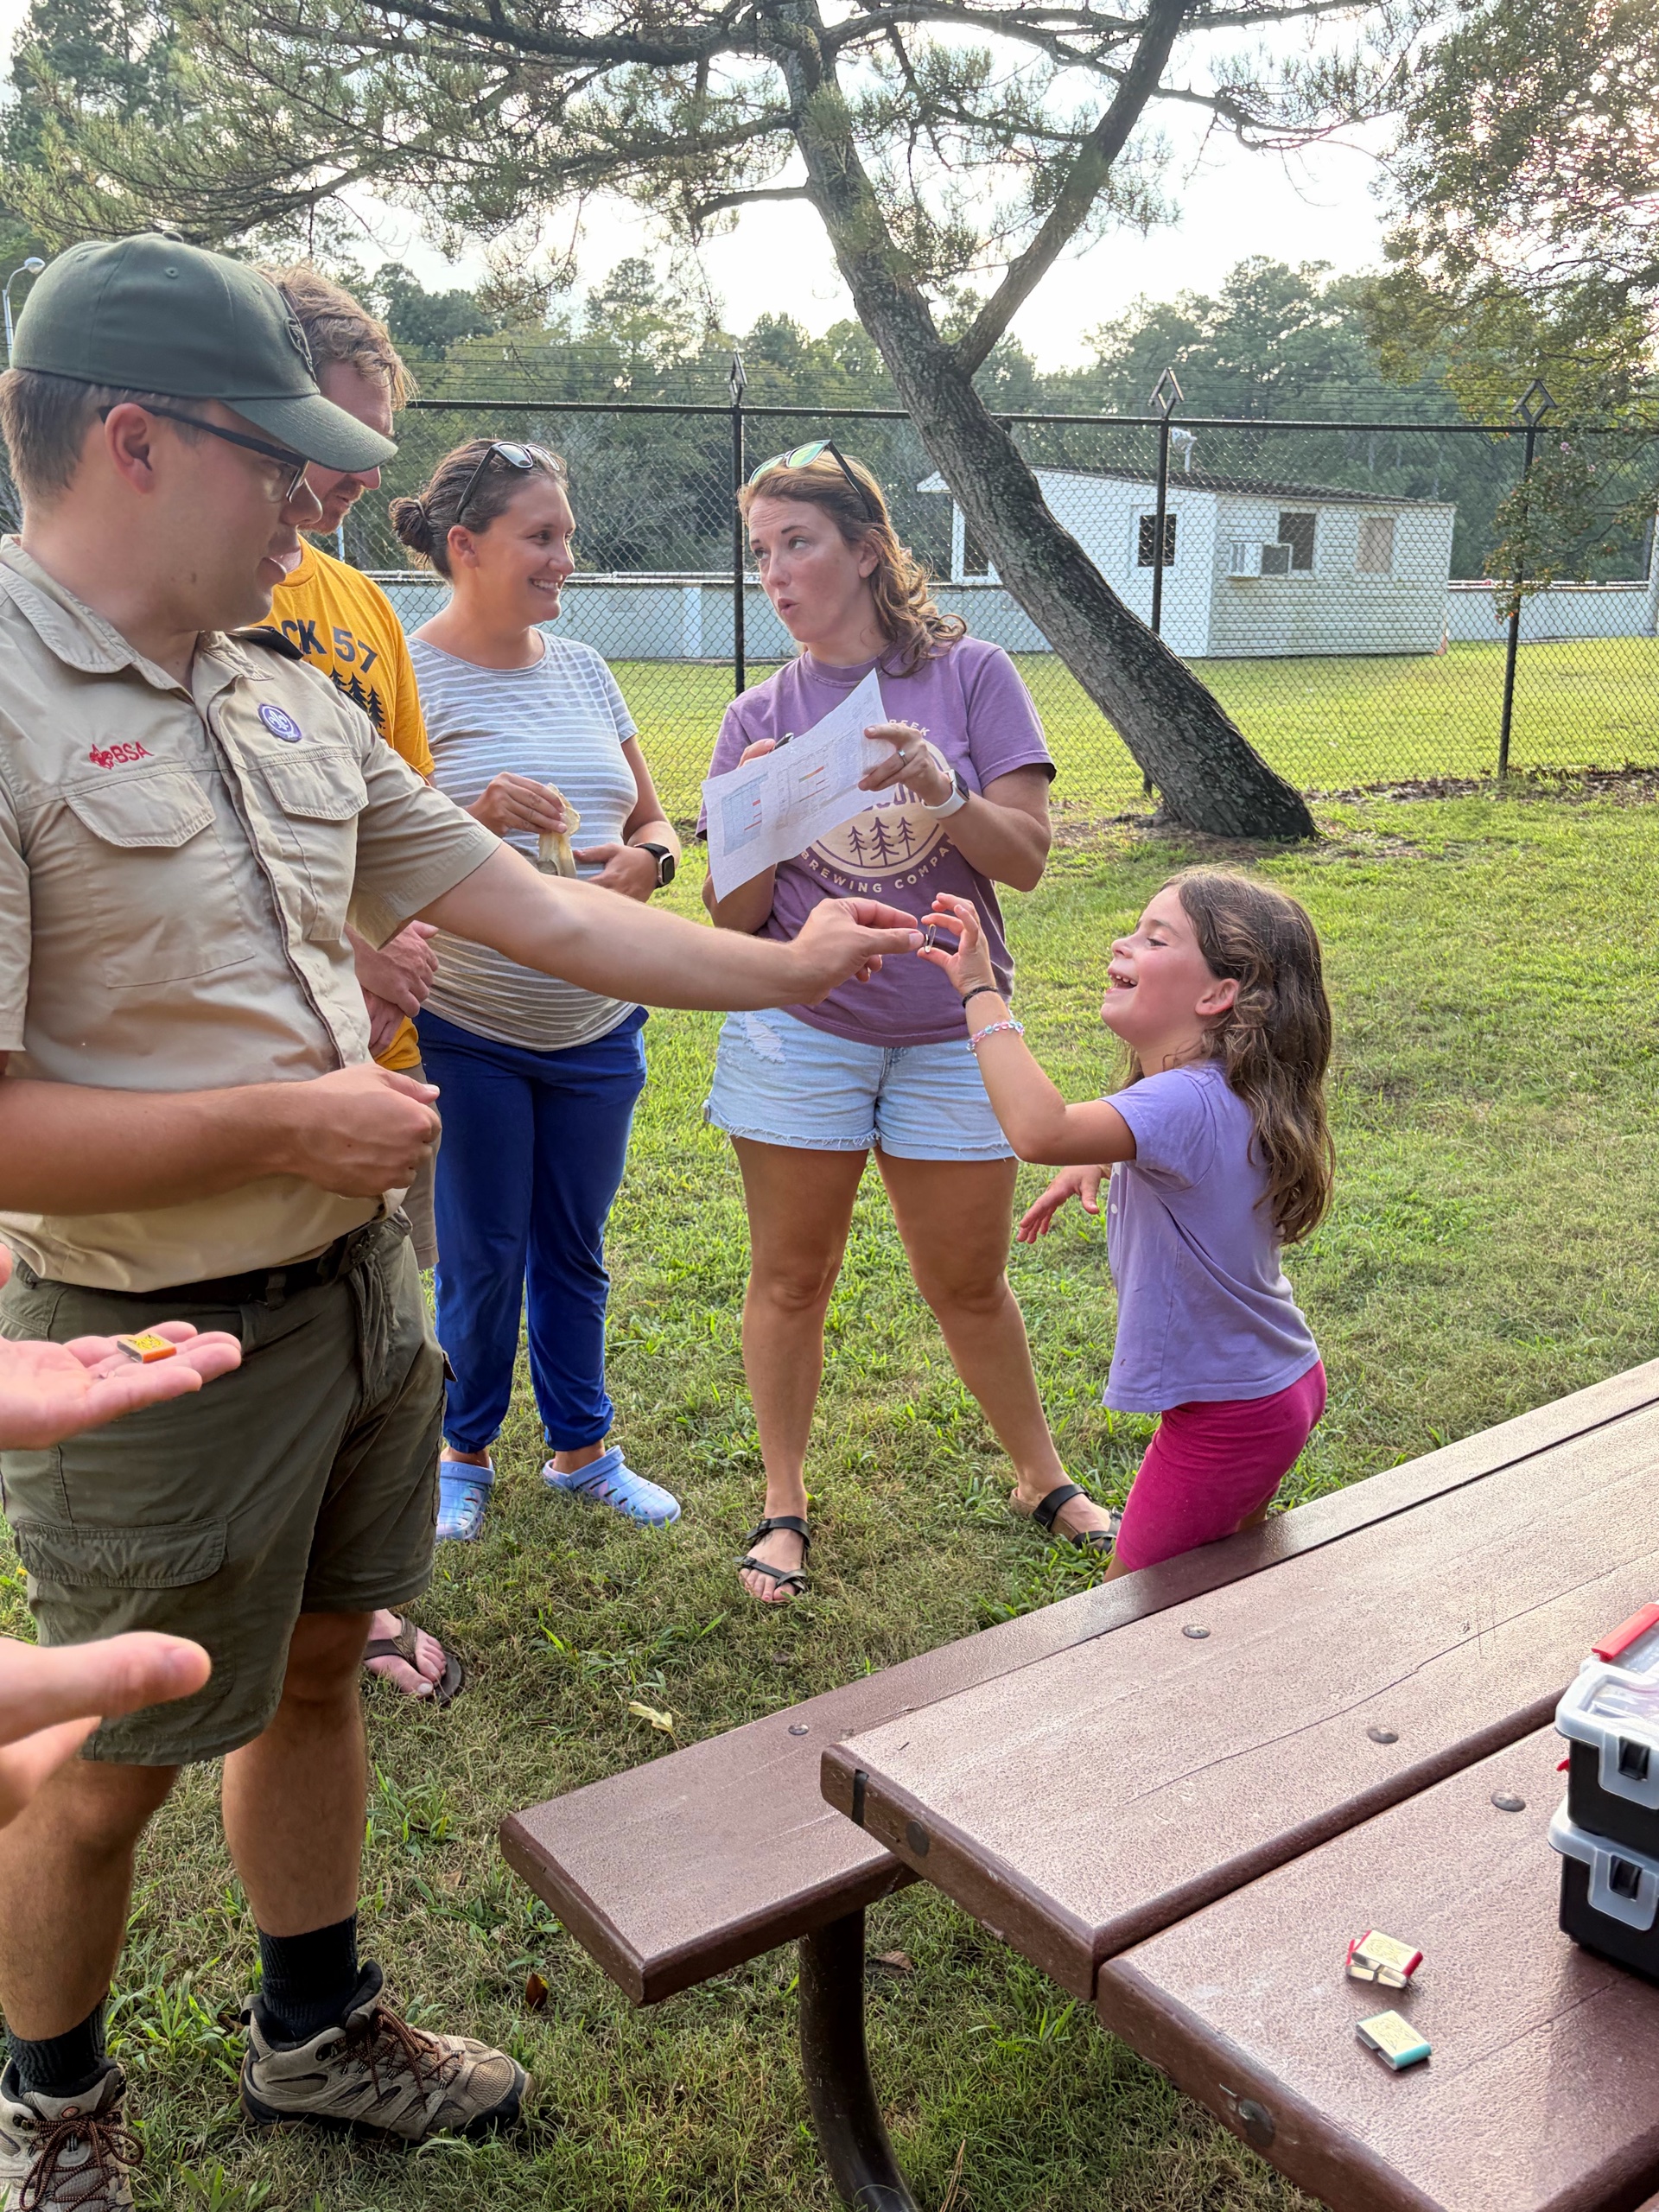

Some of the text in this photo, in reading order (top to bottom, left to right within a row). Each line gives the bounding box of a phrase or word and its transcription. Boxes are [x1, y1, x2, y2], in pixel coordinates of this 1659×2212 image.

[333, 626, 378, 674] 57
[110, 741, 154, 763] BSA
[801, 839, 955, 893] BREWING COMPA
